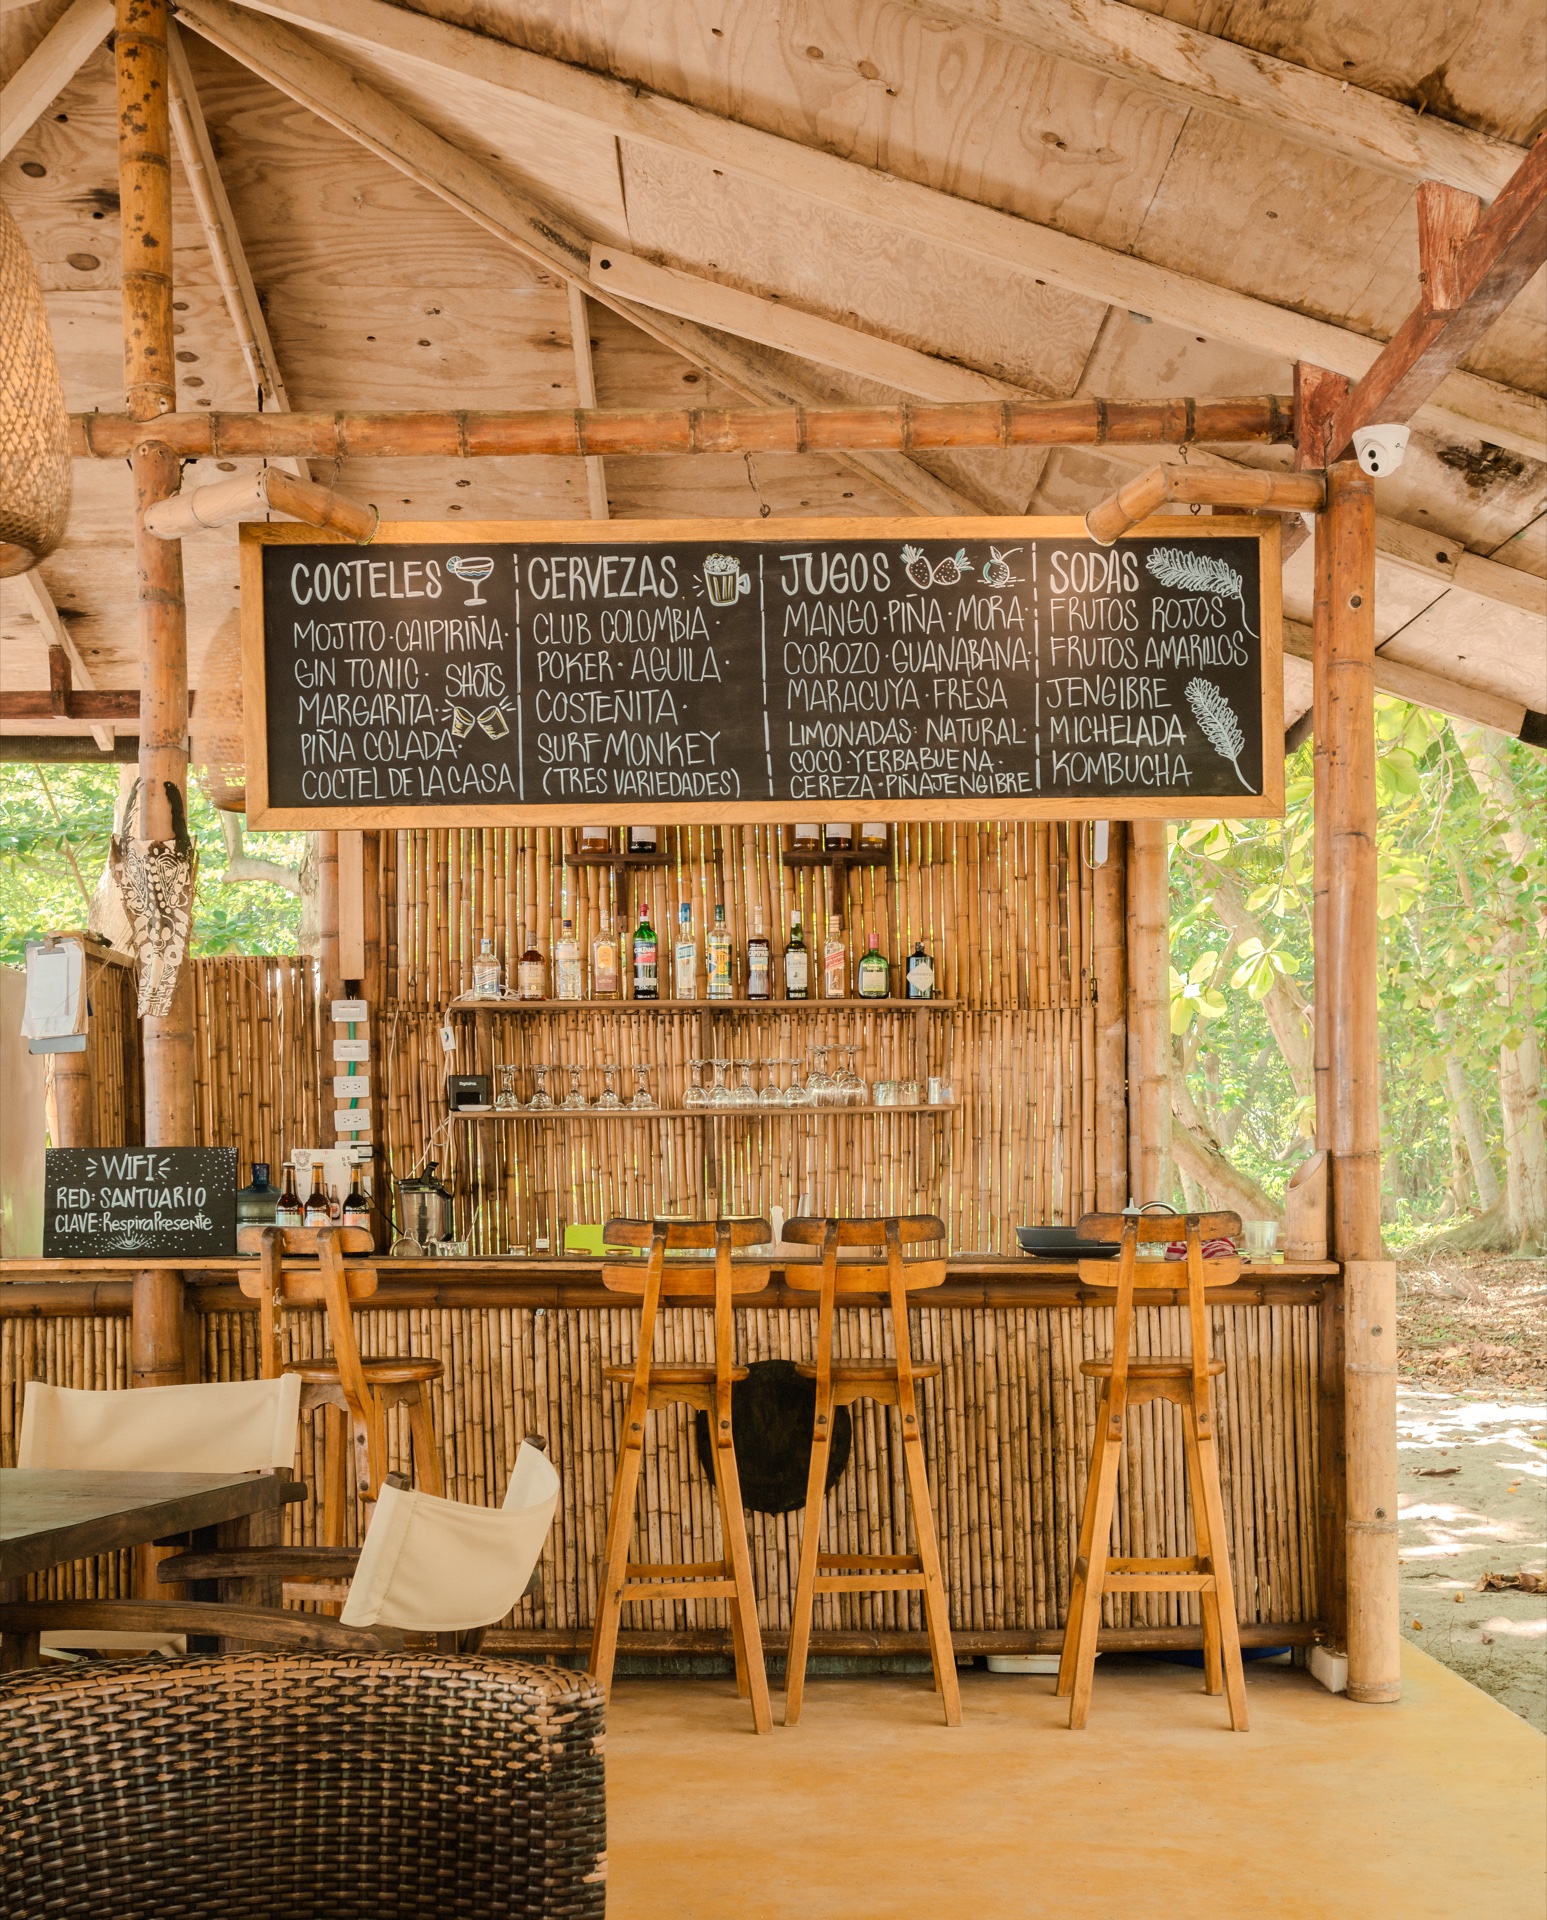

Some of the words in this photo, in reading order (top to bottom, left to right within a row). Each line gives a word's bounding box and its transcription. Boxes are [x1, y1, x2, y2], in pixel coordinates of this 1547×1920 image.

[290, 560, 442, 605] COCTELES
[528, 555, 679, 601] CERVEZAS
[780, 551, 891, 596] JUGOS
[1050, 550, 1139, 594] SODAS
[533, 612, 592, 645] CLUB
[601, 606, 710, 643] COLOMBIA
[783, 599, 878, 637] MANGO
[888, 594, 945, 634] PIÑA
[956, 594, 1025, 631] MORA
[1050, 596, 1139, 633] FRUTOS
[1152, 596, 1226, 633] ROJOS
[294, 619, 386, 652] MOJITO
[395, 615, 503, 653] CAIPIRIÑA
[1050, 635, 1138, 669] FRUTOS
[1145, 630, 1248, 671] AMARILLOS
[295, 657, 335, 689] GIN
[344, 657, 418, 689] TONIC
[537, 651, 613, 684] POKER
[631, 646, 721, 683] AGUILA
[784, 641, 879, 674] COROZO
[892, 636, 1031, 677] GUANABANA
[446, 662, 505, 697] SHOTS
[788, 678, 920, 713] MARACUYA
[933, 677, 1008, 710] FRESA
[1046, 674, 1172, 710] JENGIBRE
[299, 693, 435, 727] MARGARITA
[536, 689, 678, 725] COSTEÑITA
[301, 729, 356, 766] PIÑA
[363, 729, 457, 761] COLADA
[789, 718, 917, 748] LIMONADAS:
[926, 715, 1026, 746] NATURAL
[1051, 713, 1187, 747] MICHELADA
[538, 732, 602, 763] SURF
[604, 730, 721, 767] MONKEY
[790, 750, 842, 773] COCO
[850, 747, 994, 773] YERBABUENA
[302, 767, 387, 800] COCTEL
[389, 768, 413, 797] DE
[418, 765, 445, 796] LA
[448, 763, 515, 794] CASA
[543, 767, 608, 795] (TRES
[614, 768, 740, 798] VARIEDADES)
[1052, 750, 1193, 786] KOMBUCHA
[790, 774, 875, 799] CEREZA
[101, 1153, 157, 1181] WIFI
[56, 1186, 95, 1209] RED:
[100, 1186, 206, 1209] SANTUARIO
